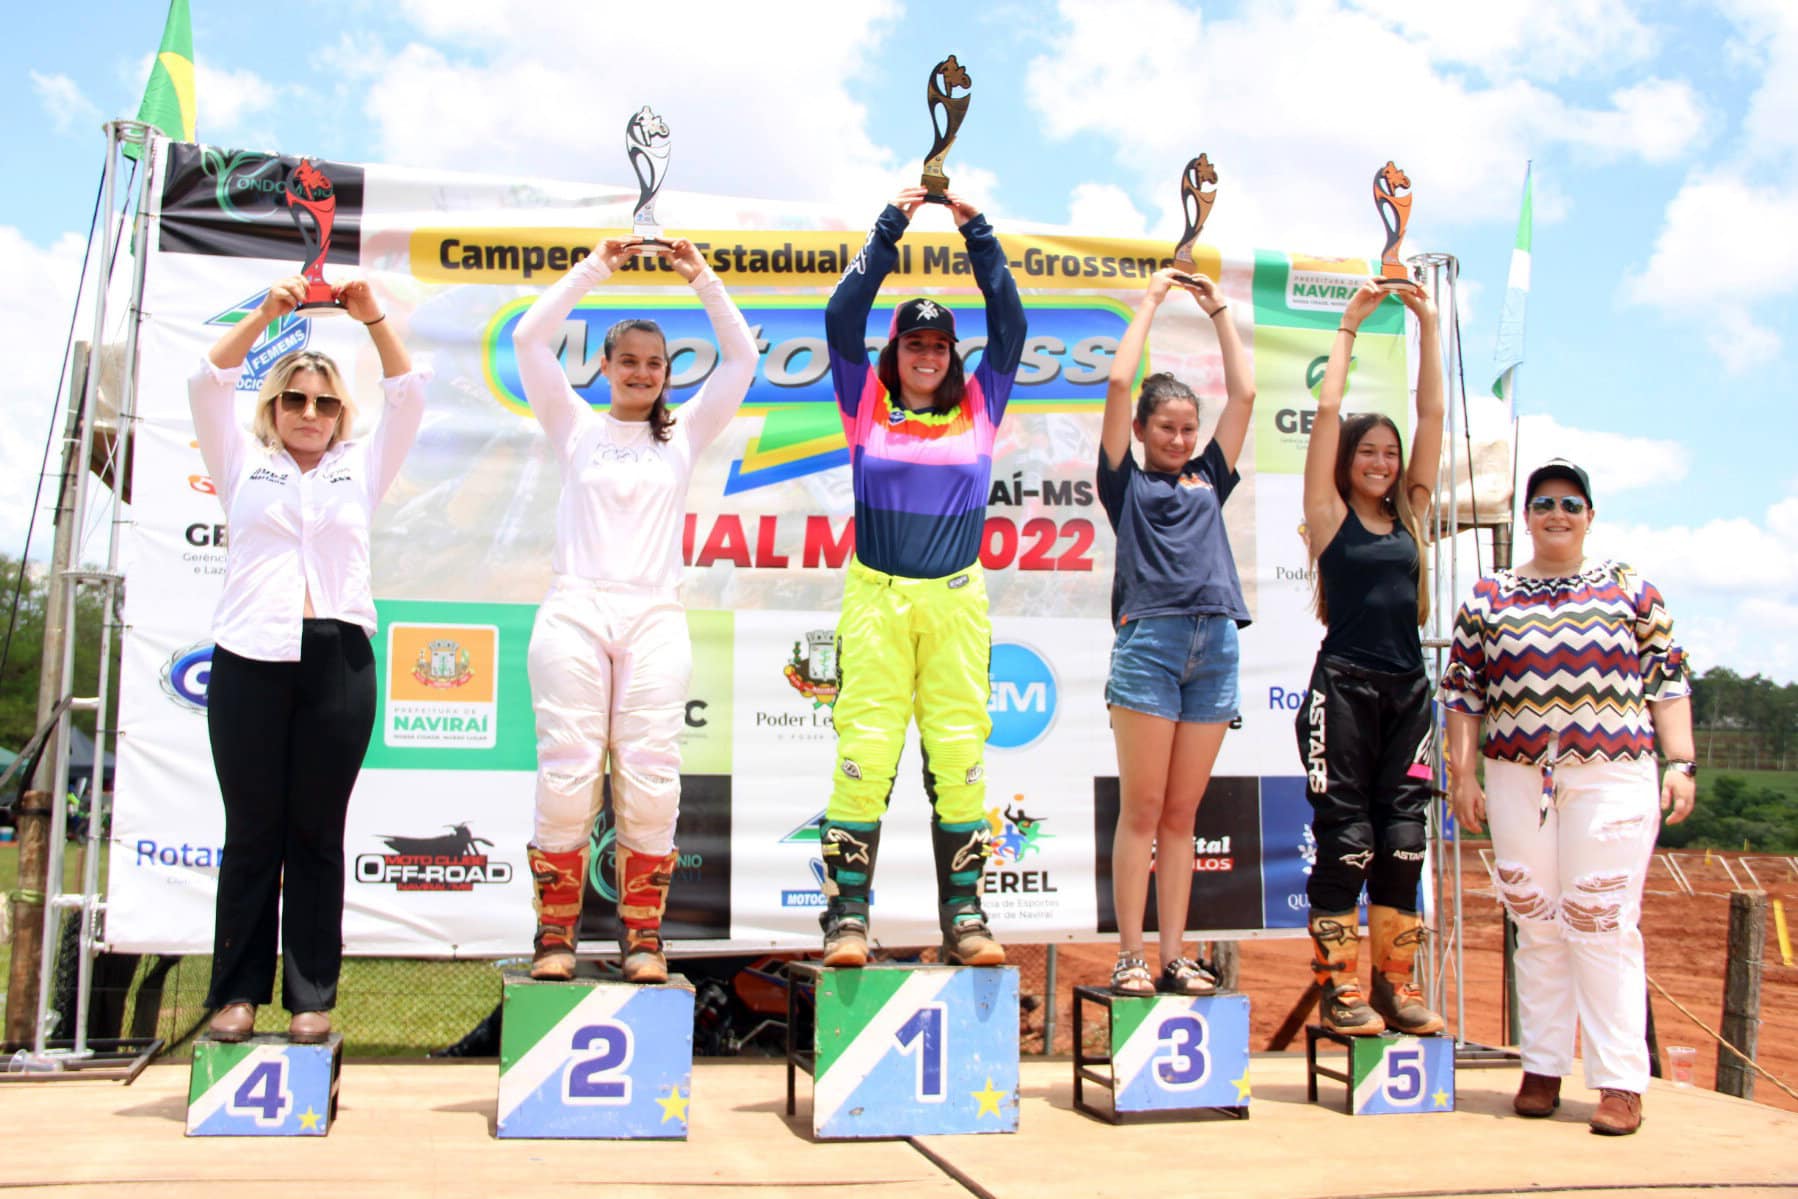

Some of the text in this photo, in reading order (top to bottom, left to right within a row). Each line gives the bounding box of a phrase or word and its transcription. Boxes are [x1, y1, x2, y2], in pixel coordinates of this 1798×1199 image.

[253, 329, 305, 369] FEMEMS
[978, 516, 1096, 571] 022
[393, 714, 488, 733] NAVIRAÍ
[756, 711, 807, 726] Poder
[1309, 689, 1329, 795] ASTARS
[356, 854, 512, 883] OFF-ROAD
[1193, 858, 1232, 871] LOS
[568, 1023, 629, 1099] 2
[894, 1006, 943, 1097] 1
[1156, 1015, 1205, 1084] 3
[1386, 1050, 1424, 1100] 5
[232, 1060, 287, 1121] 4
